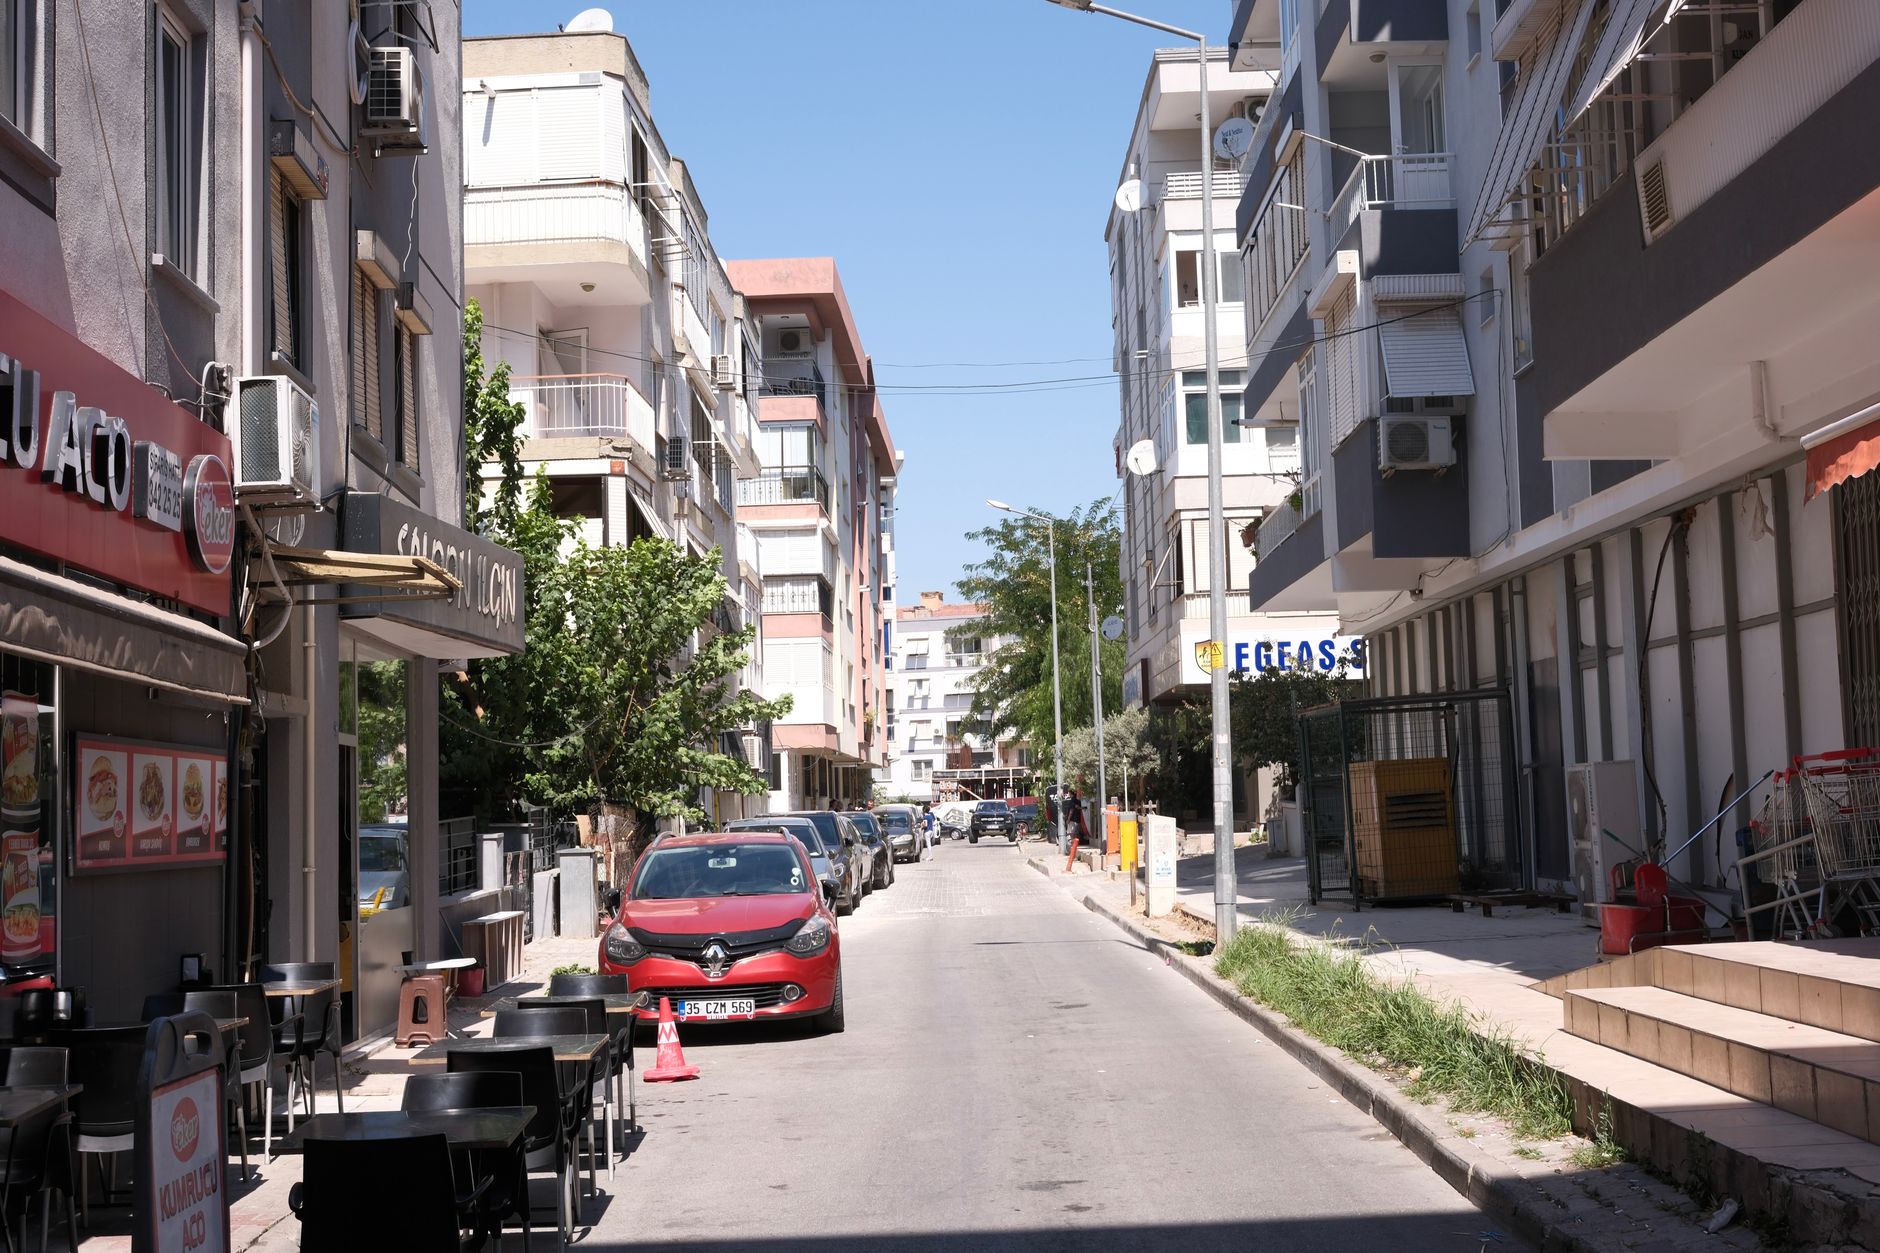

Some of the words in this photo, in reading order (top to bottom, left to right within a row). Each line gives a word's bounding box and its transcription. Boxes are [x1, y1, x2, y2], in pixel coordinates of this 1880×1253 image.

[148, 479, 162, 511] 342
[163, 485, 172, 515] 25
[173, 490, 181, 519] 25
[686, 1002, 700, 1015] 35
[705, 1002, 727, 1014] CZM
[731, 1001, 752, 1014] 569
[159, 1158, 218, 1222] KUMRUCU
